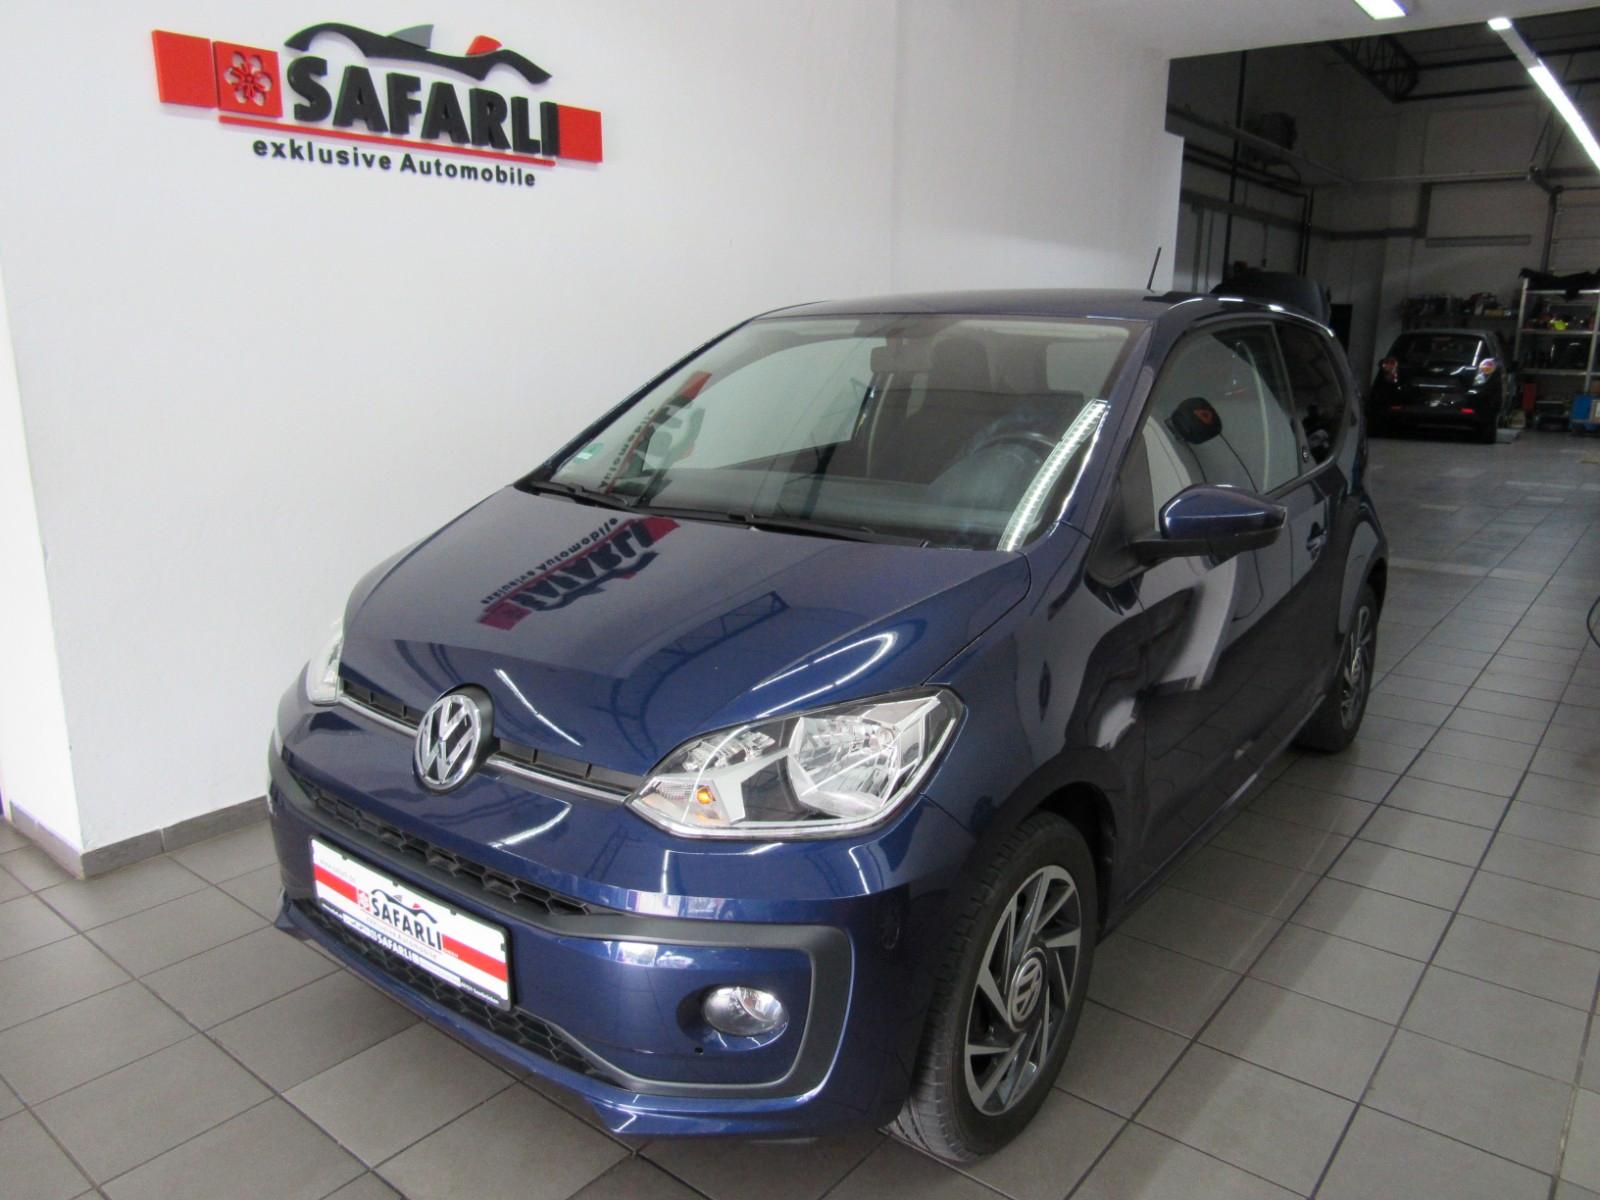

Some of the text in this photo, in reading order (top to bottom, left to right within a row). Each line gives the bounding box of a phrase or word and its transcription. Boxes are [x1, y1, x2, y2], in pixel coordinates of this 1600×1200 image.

[287, 56, 559, 157] SAFARLI
[252, 138, 536, 187] exklusive Automobile
[371, 897, 442, 951] SAFARLI
